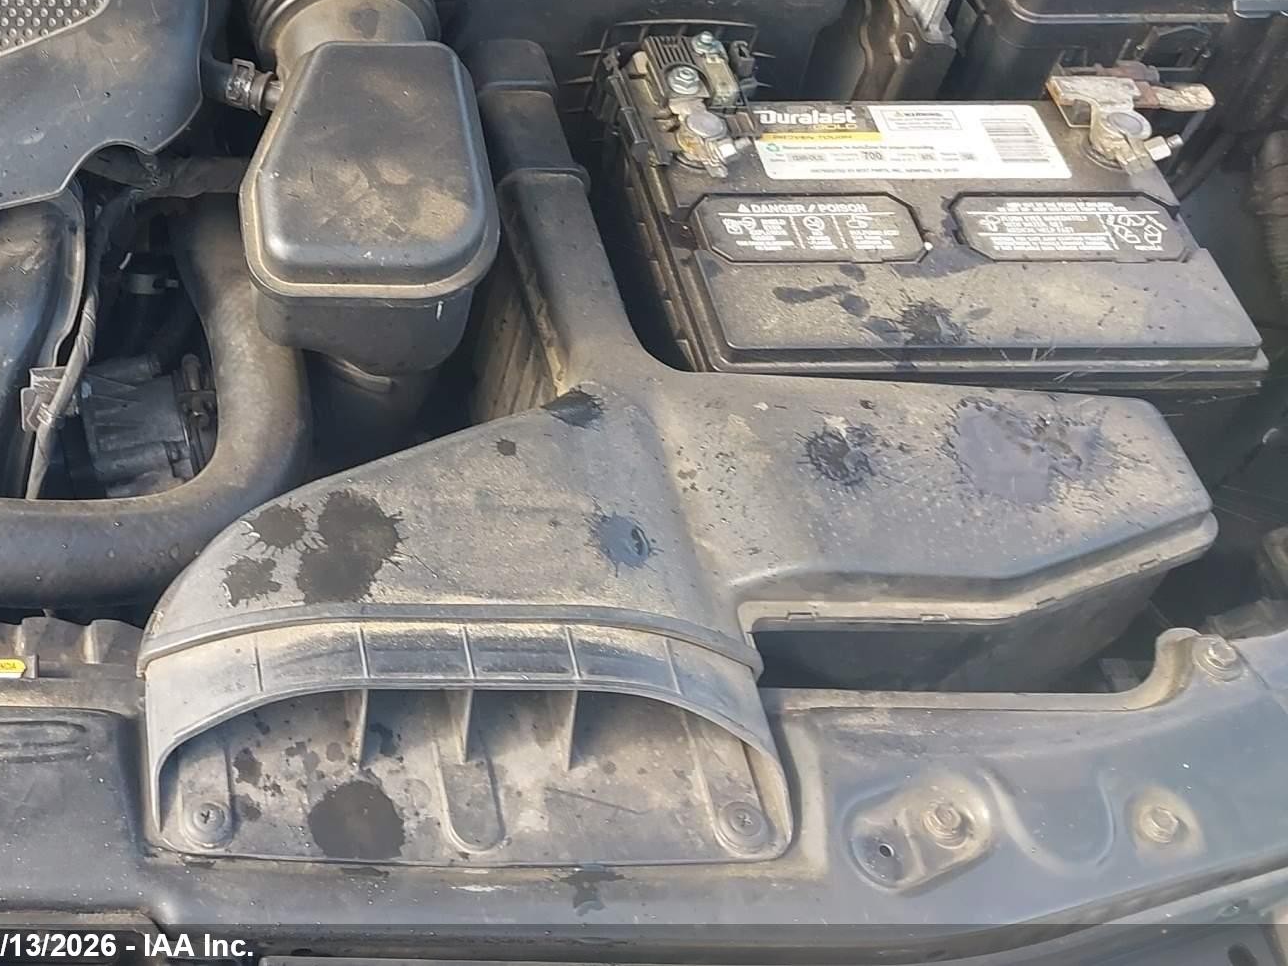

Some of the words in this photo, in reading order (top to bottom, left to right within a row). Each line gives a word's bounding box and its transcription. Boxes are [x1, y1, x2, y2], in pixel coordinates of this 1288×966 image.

[754, 109, 857, 125] Duralast
[813, 123, 858, 131] GOLD
[864, 151, 883, 161] 700
[750, 203, 807, 213] DANGER
[817, 203, 869, 213] POISON
